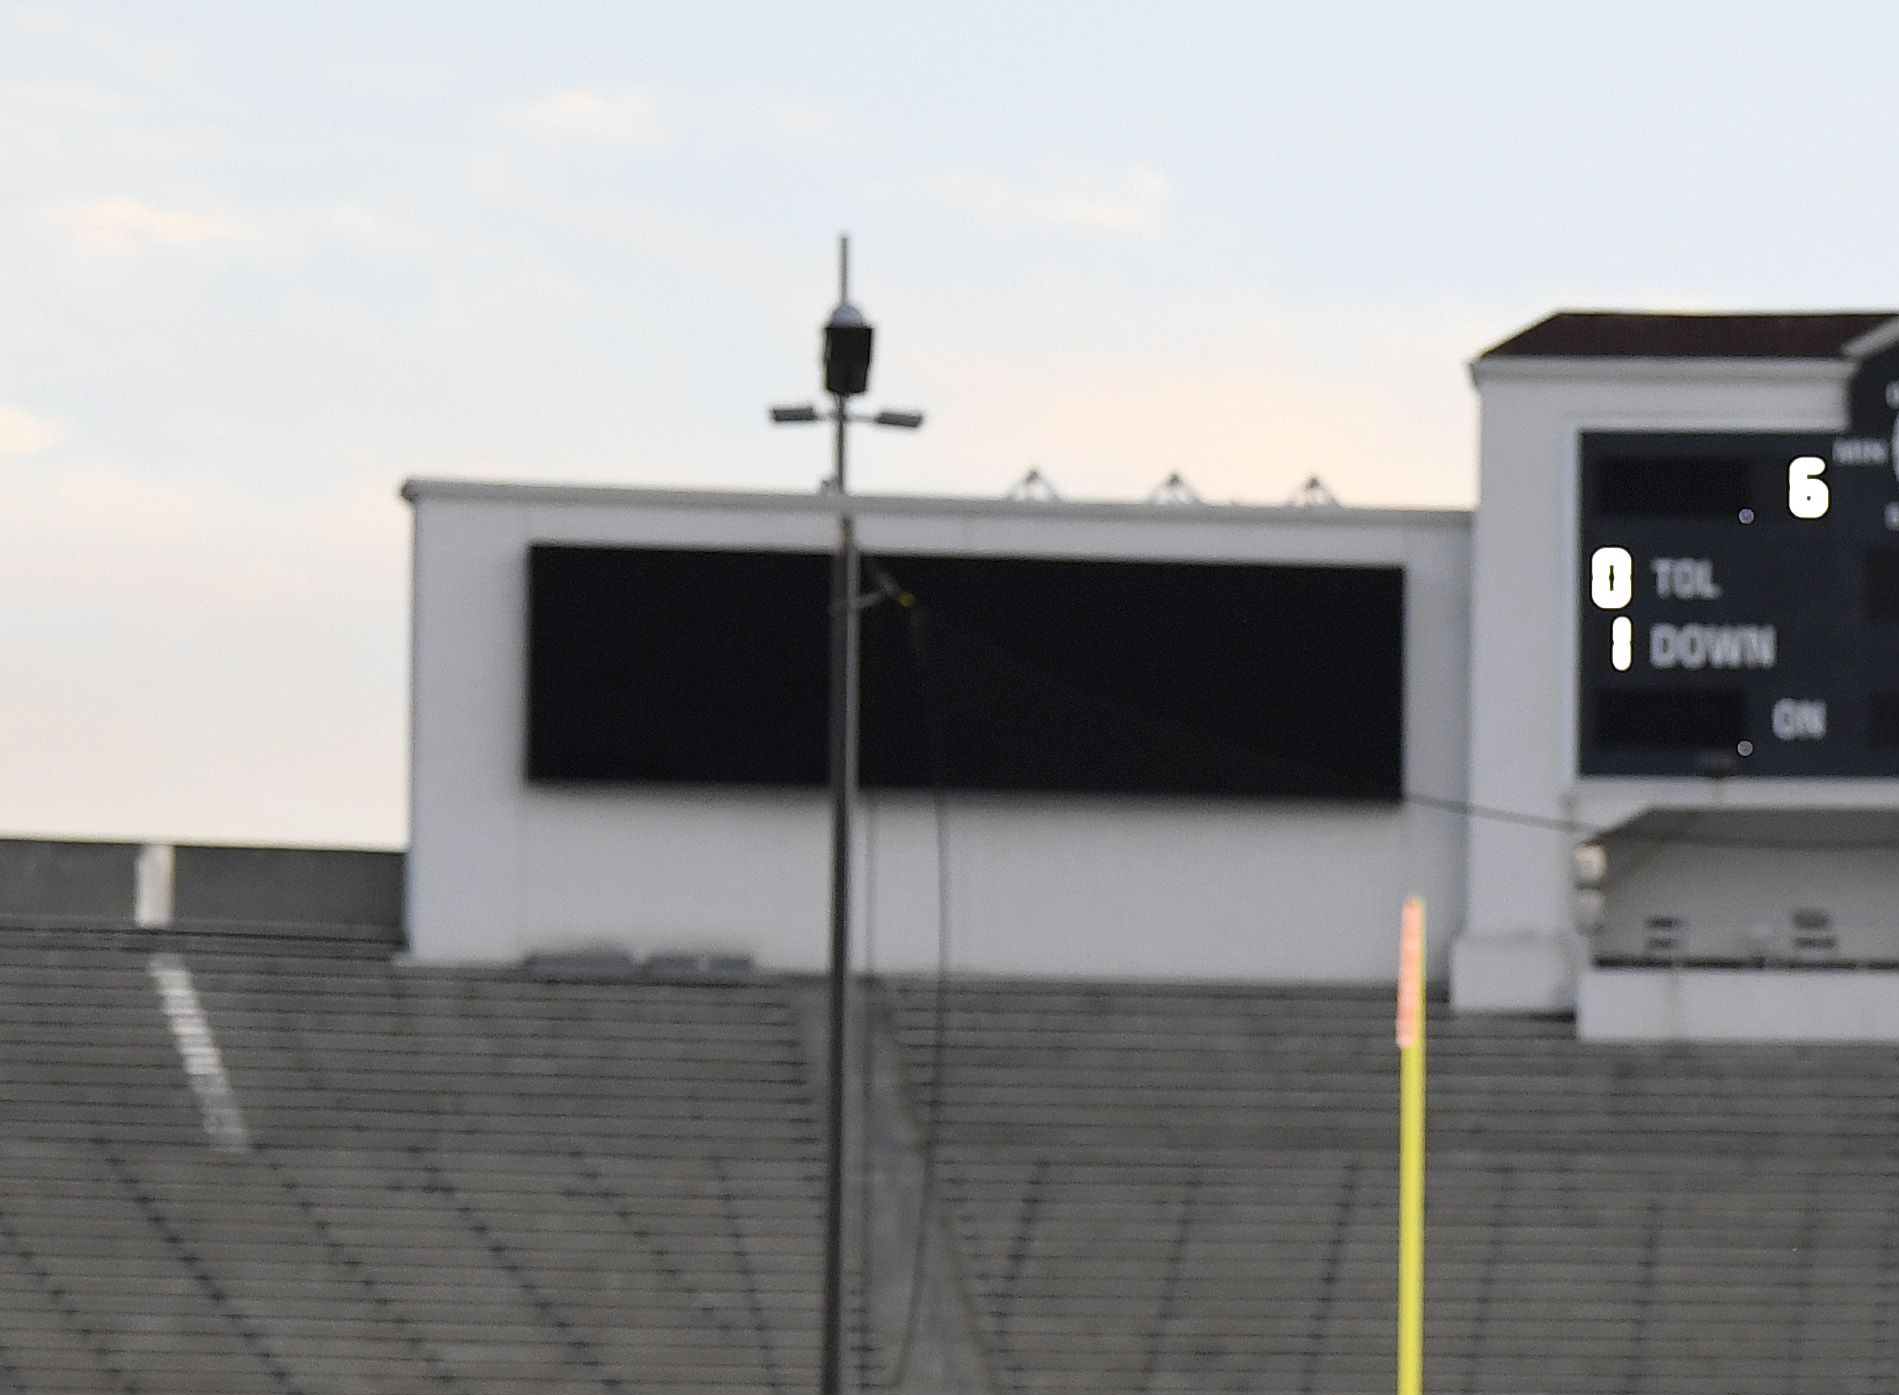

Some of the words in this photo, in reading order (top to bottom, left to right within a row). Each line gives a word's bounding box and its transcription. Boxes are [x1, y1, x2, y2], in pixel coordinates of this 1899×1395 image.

[1789, 456, 1829, 519] 6
[1591, 547, 1632, 609] 0
[1651, 558, 1722, 600] TOL
[1612, 616, 1632, 671] 1
[1649, 623, 1777, 669] DOWN
[1771, 698, 1828, 741] ON
